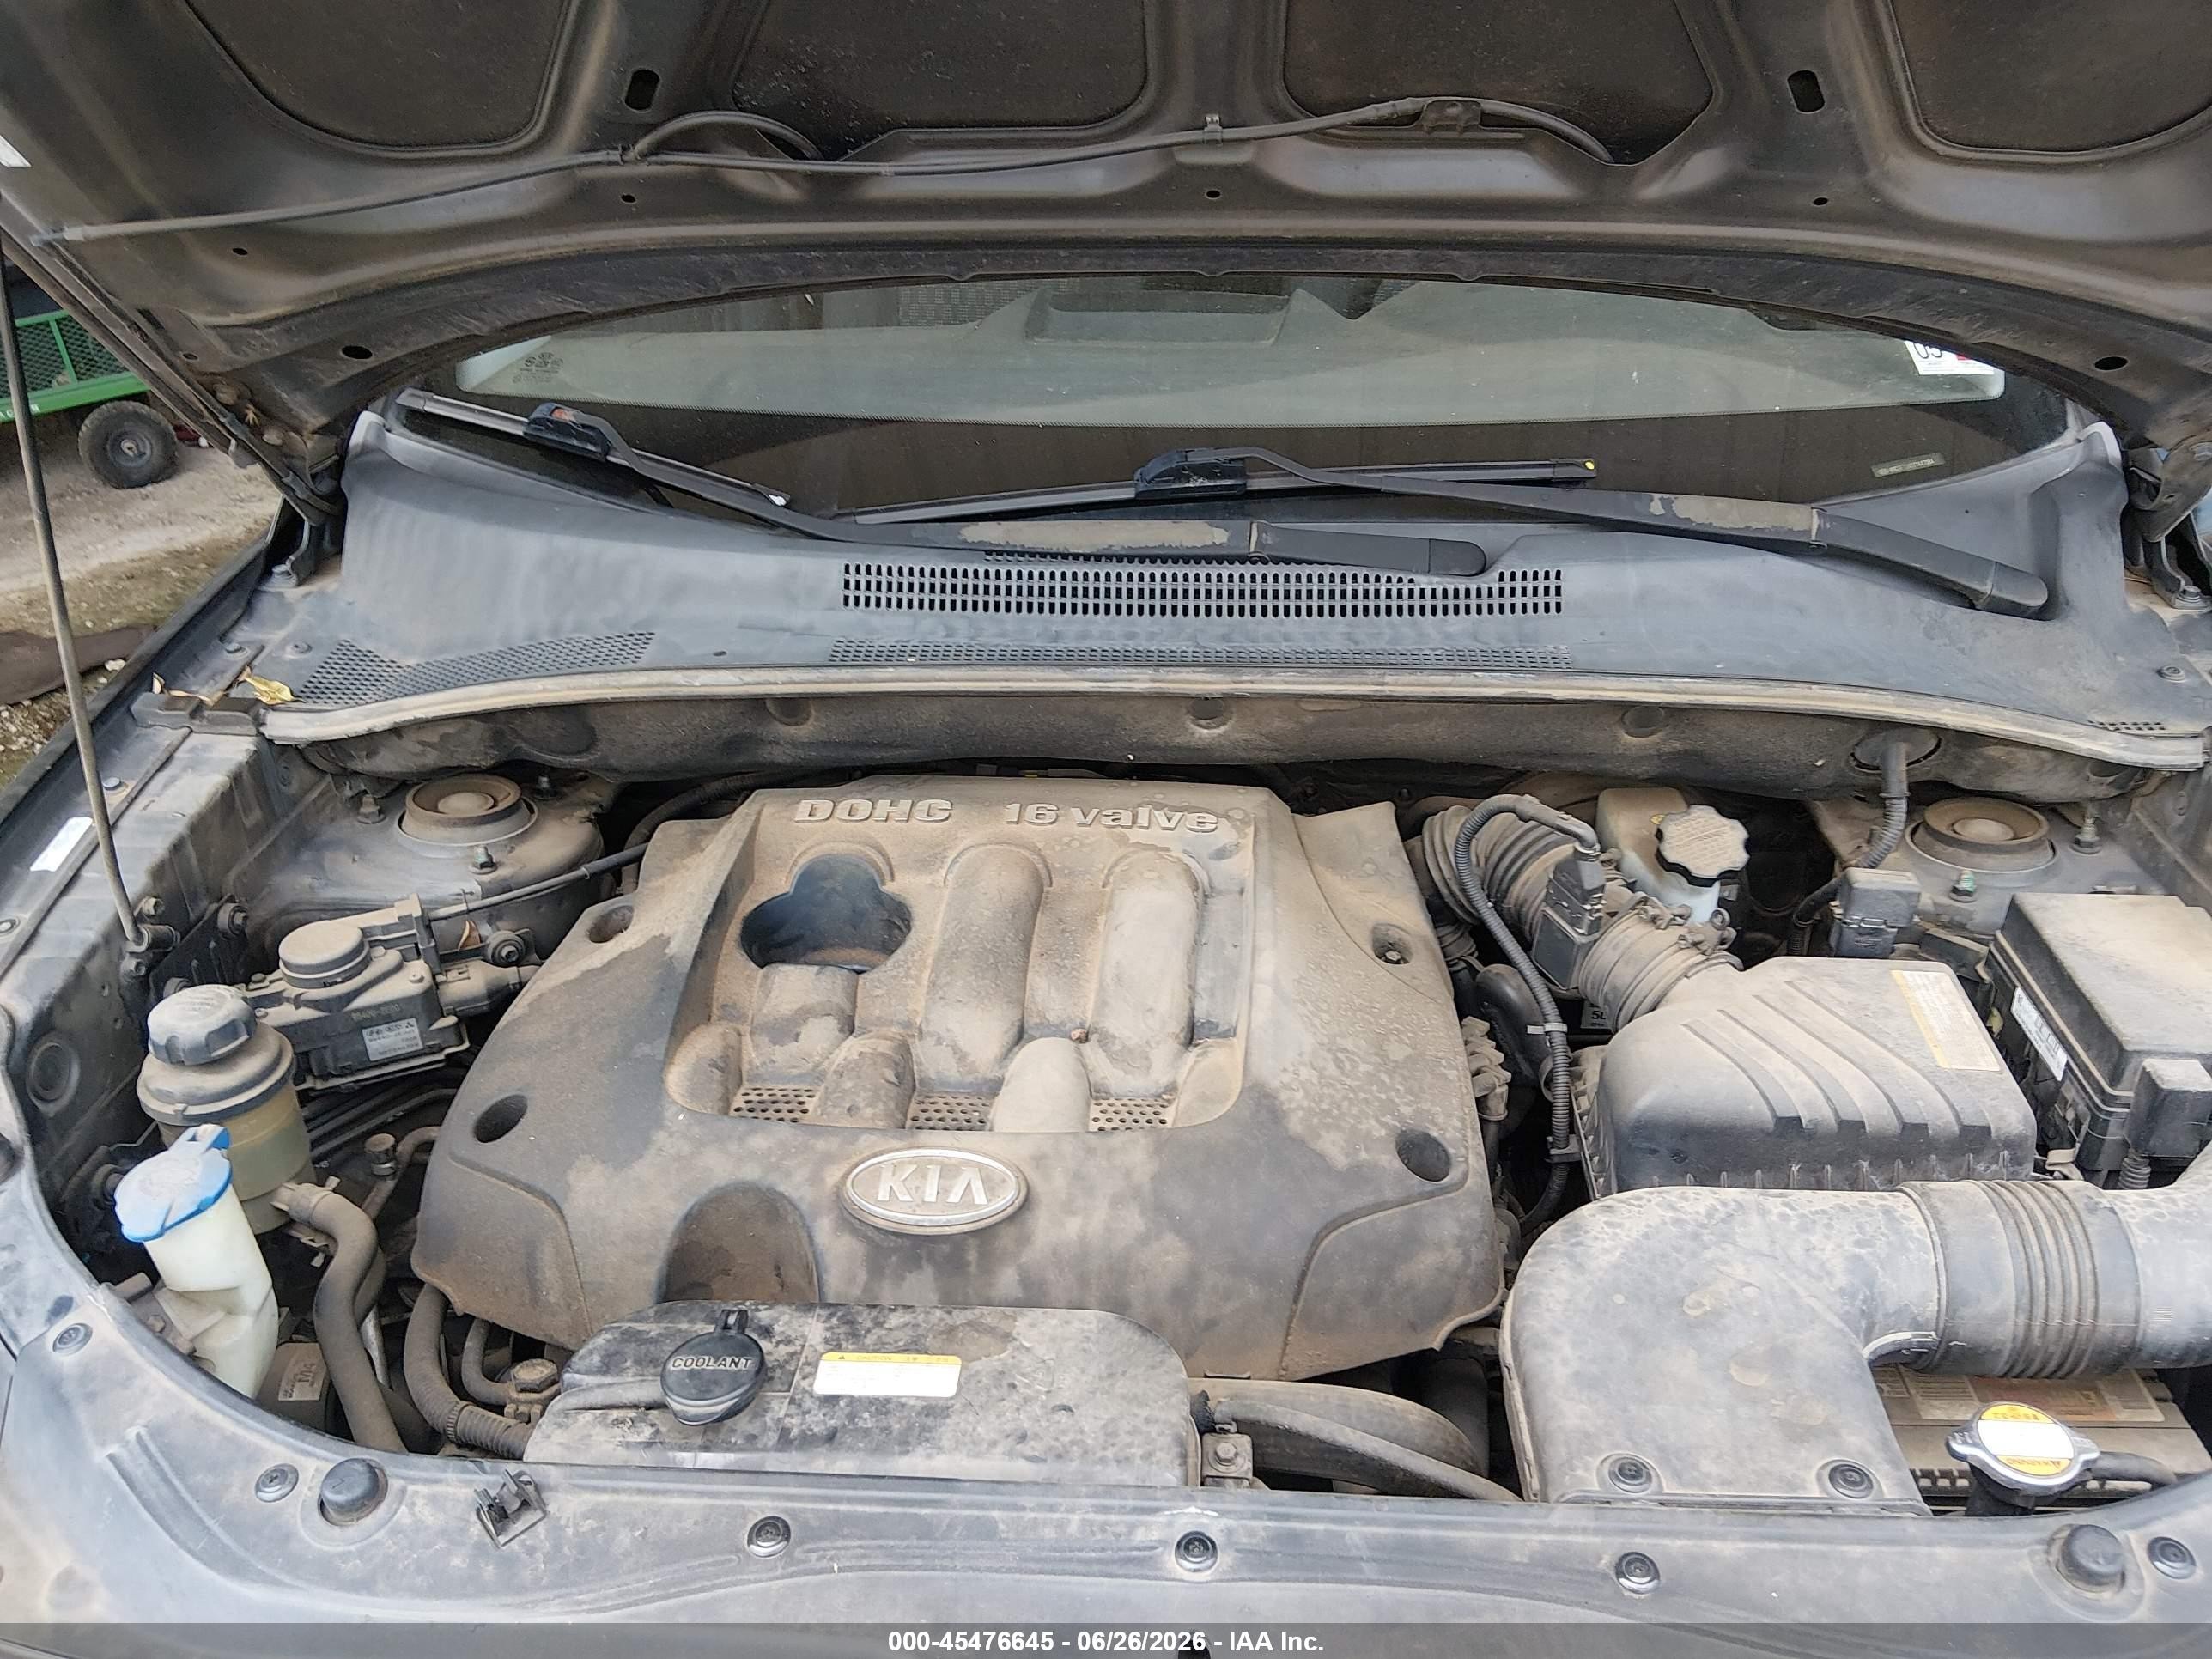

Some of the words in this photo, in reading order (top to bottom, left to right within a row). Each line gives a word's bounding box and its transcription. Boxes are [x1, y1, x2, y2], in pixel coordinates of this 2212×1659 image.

[794, 799, 953, 824] DOHC
[1004, 802, 1060, 826] 16
[1074, 807, 1219, 832] valve
[877, 1164, 988, 1206] KIA
[671, 1357, 753, 1370] COOLANT
